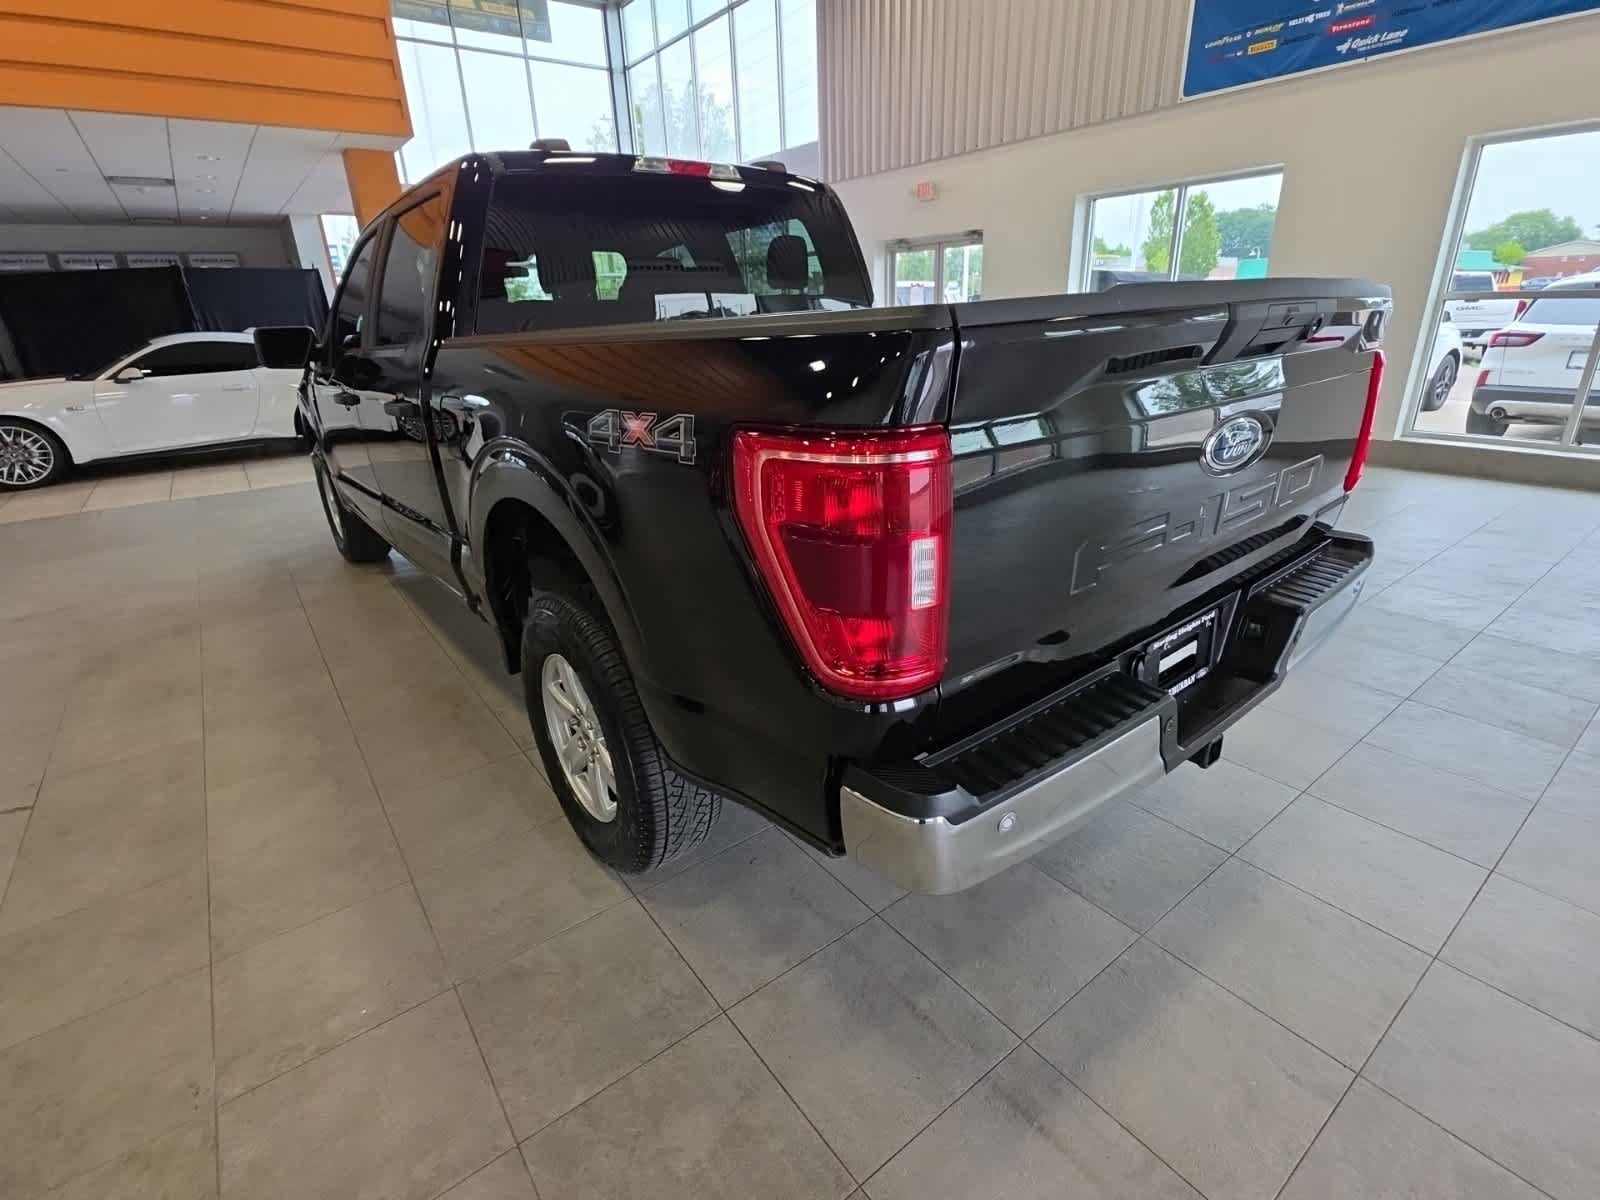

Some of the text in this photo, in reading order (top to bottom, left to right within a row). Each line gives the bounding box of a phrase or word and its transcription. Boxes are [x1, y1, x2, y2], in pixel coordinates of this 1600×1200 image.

[1352, 29, 1408, 48] Quick Lane
[1070, 454, 1325, 596] F-150
[1201, 610, 1216, 623] Ford
